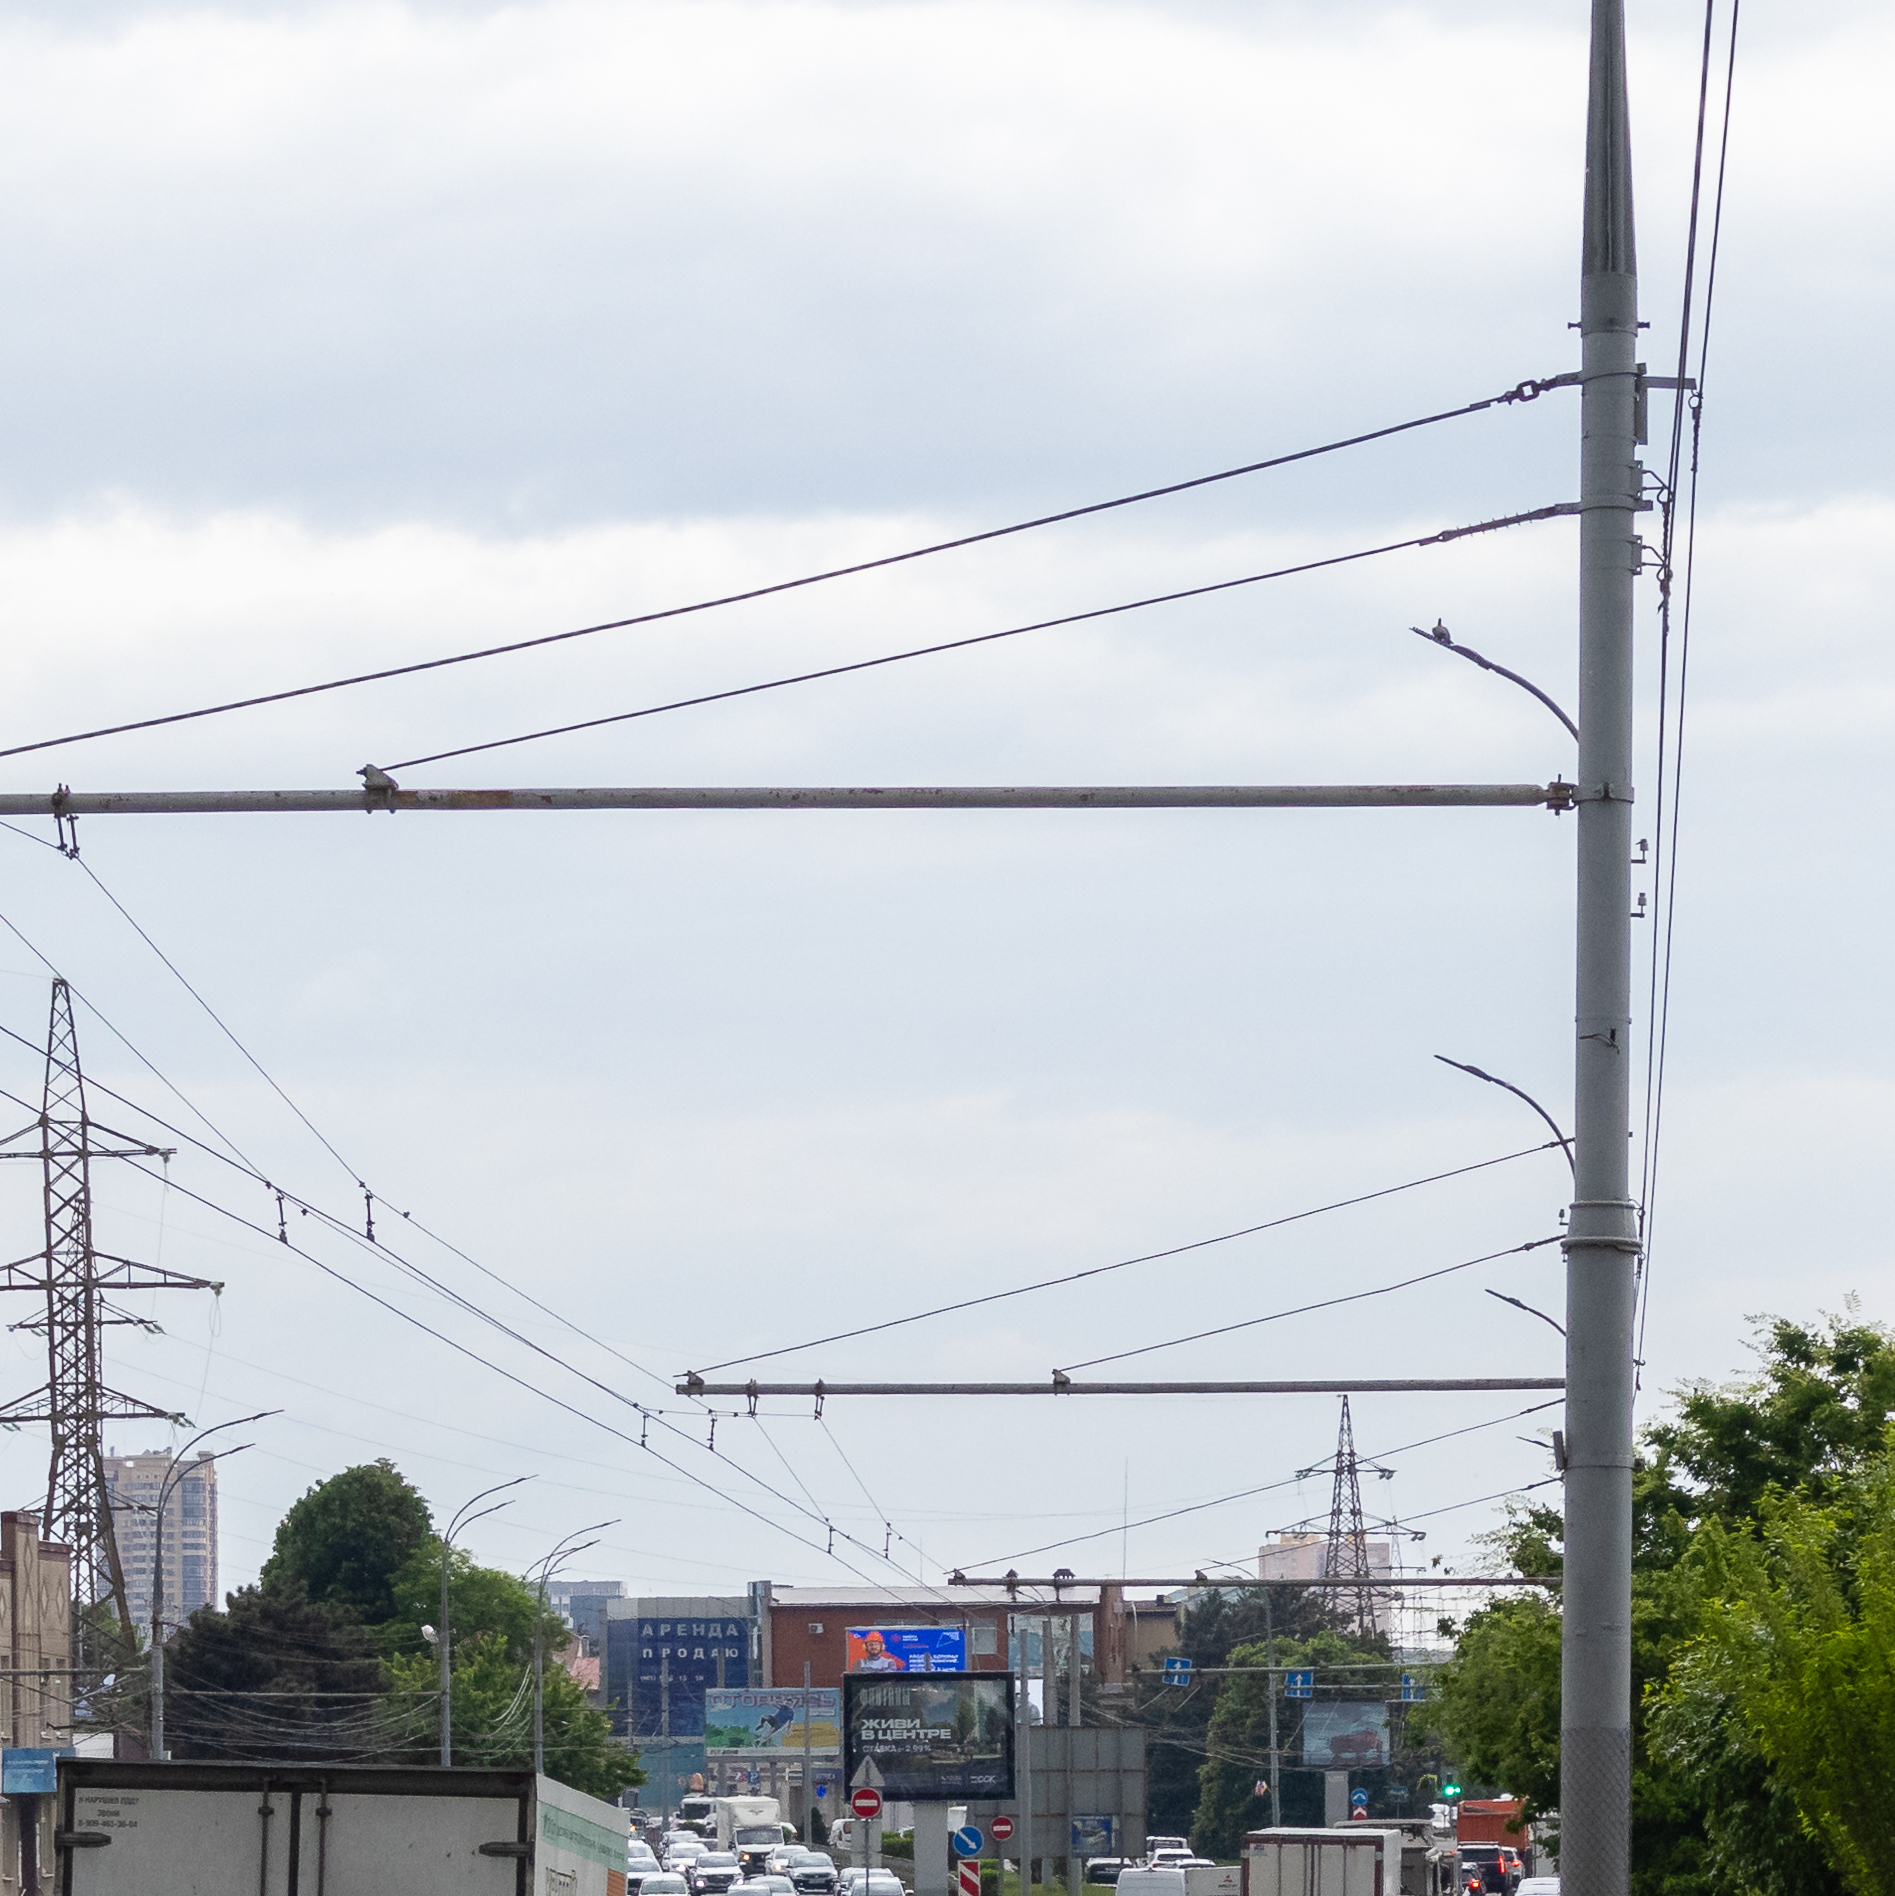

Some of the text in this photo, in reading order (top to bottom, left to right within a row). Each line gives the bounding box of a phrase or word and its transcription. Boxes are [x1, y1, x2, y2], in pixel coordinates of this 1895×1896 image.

[642, 1623, 739, 1639] АРЕНДА
[642, 1647, 739, 1660] ПРОДАЮ
[861, 1718, 920, 1729] ЖИВИ
[861, 1728, 952, 1741] В ЦЕНТРЕ
[862, 1744, 897, 1753] СТАВКА
